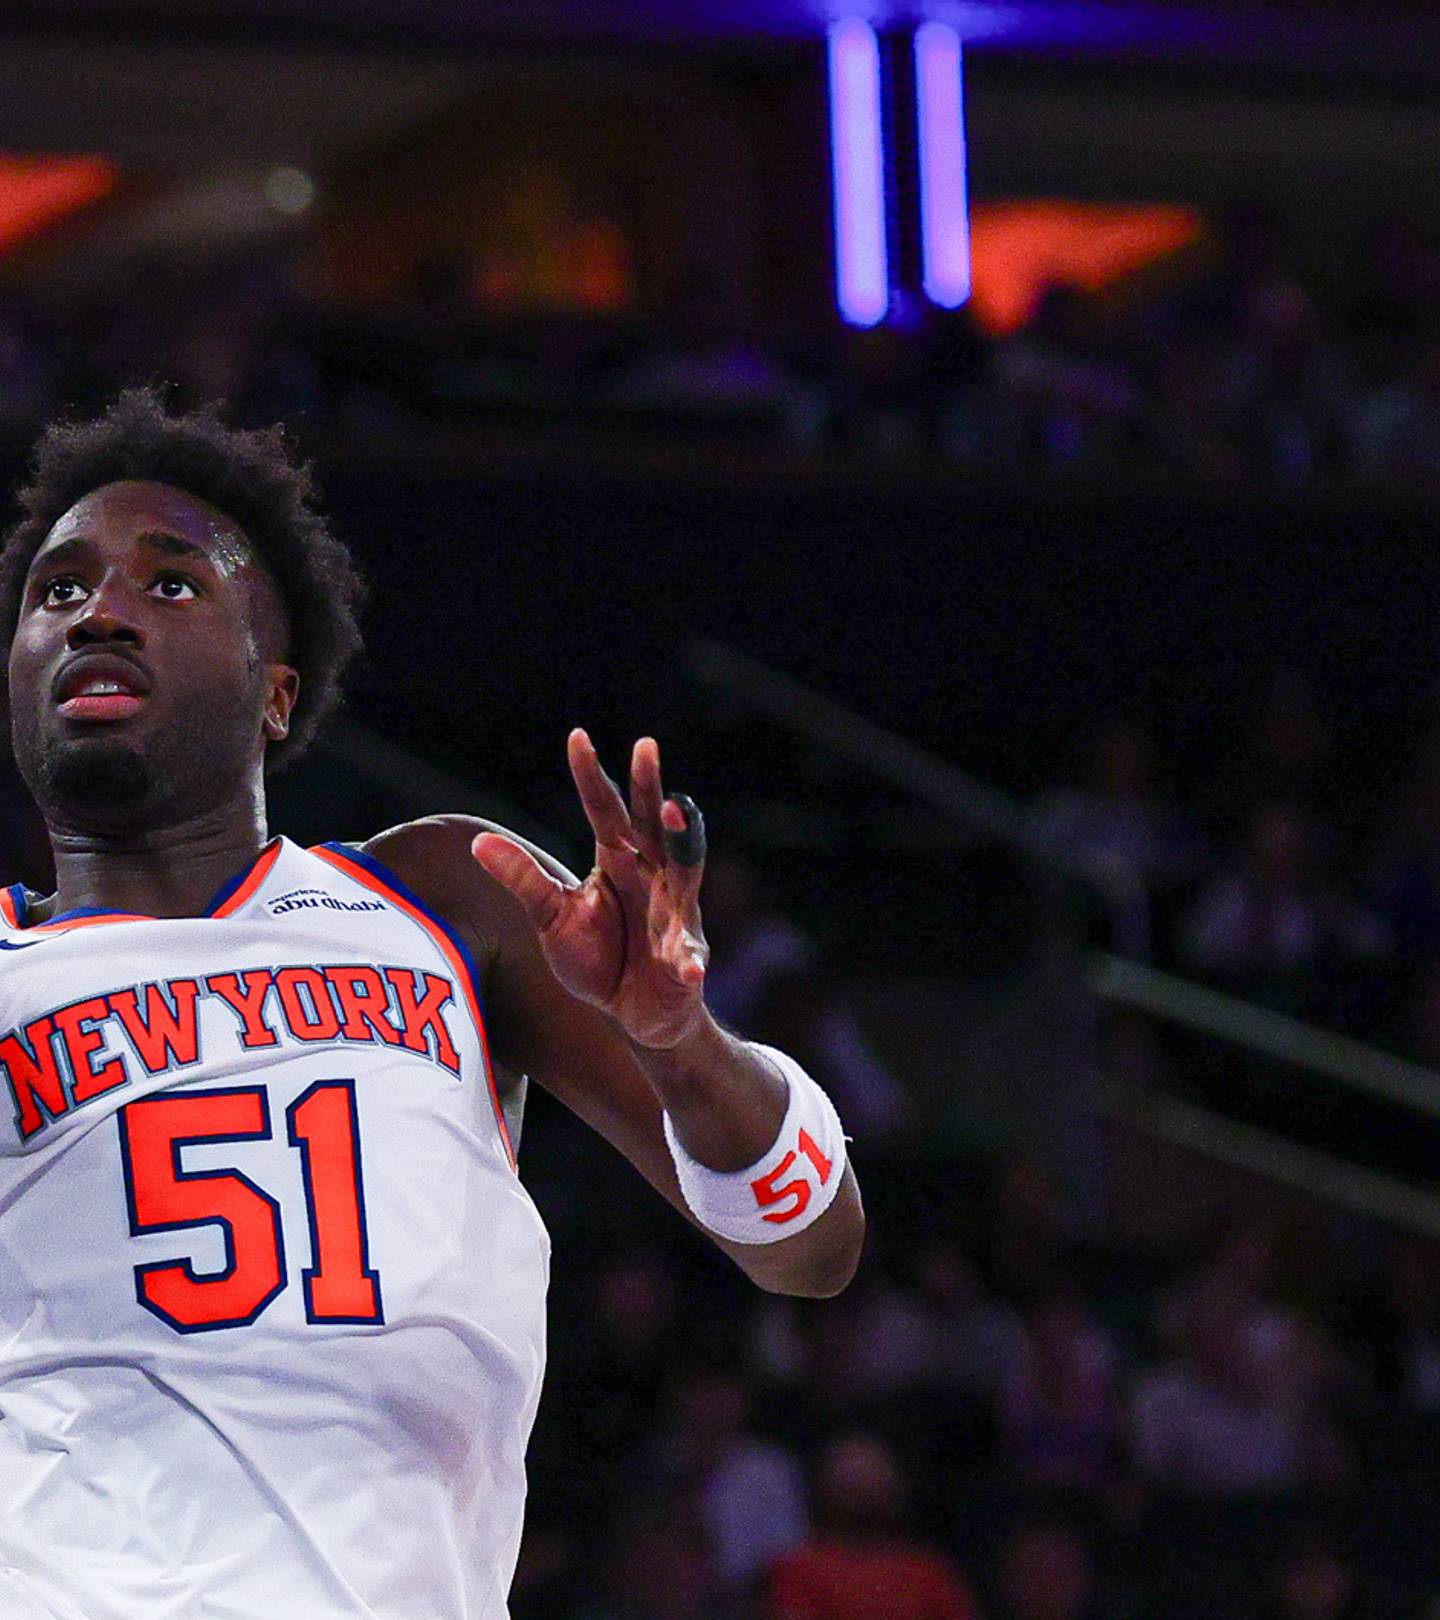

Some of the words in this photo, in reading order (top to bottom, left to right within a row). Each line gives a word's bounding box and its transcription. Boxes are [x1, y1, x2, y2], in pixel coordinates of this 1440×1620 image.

[272, 898, 319, 914] abu
[322, 898, 388, 911] dhabi
[204, 962, 462, 1081] YORK
[117, 1078, 385, 1335] 51
[750, 1127, 832, 1223] 51
